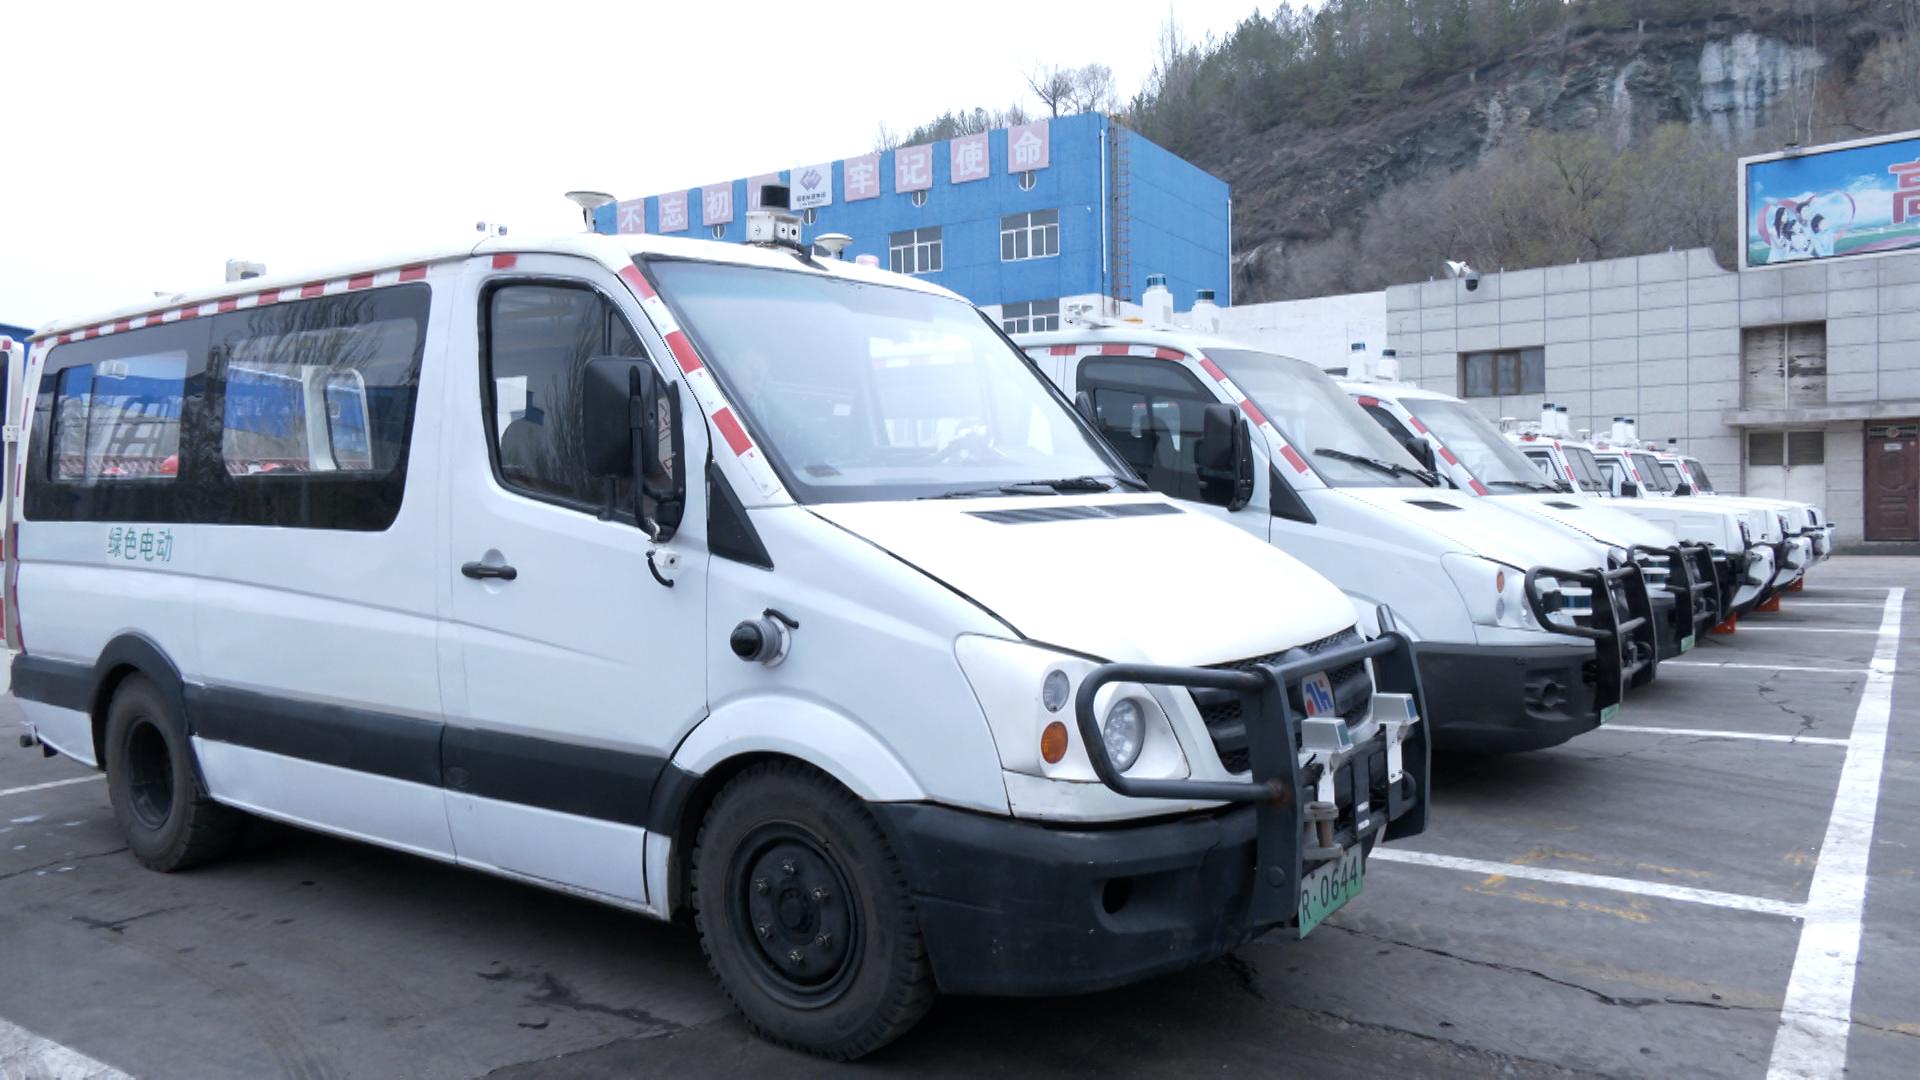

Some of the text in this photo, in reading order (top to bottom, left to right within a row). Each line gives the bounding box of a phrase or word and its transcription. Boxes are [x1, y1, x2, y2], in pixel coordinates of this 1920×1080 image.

[620, 131, 1042, 232] 不忘初 牢记使命
[107, 526, 174, 562] 绿色电动
